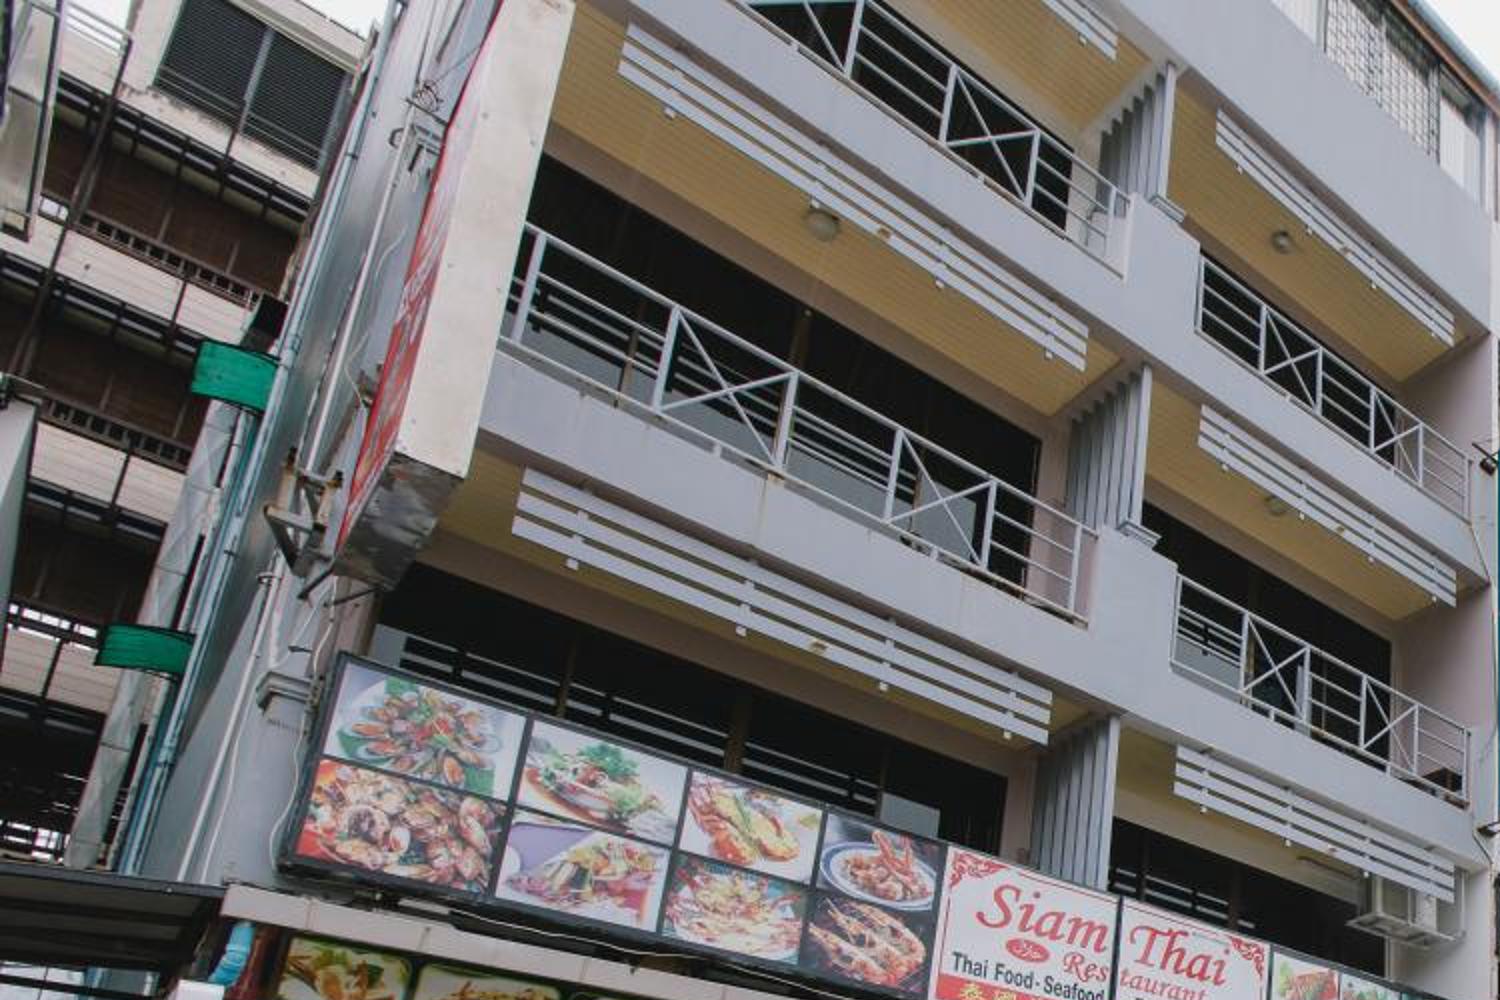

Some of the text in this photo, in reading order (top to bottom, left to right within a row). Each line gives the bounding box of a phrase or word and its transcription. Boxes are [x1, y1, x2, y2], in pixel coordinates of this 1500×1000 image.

[952, 951, 989, 978] Thai
[994, 963, 1033, 989] Food
[976, 884, 1231, 987] Siam Thai
